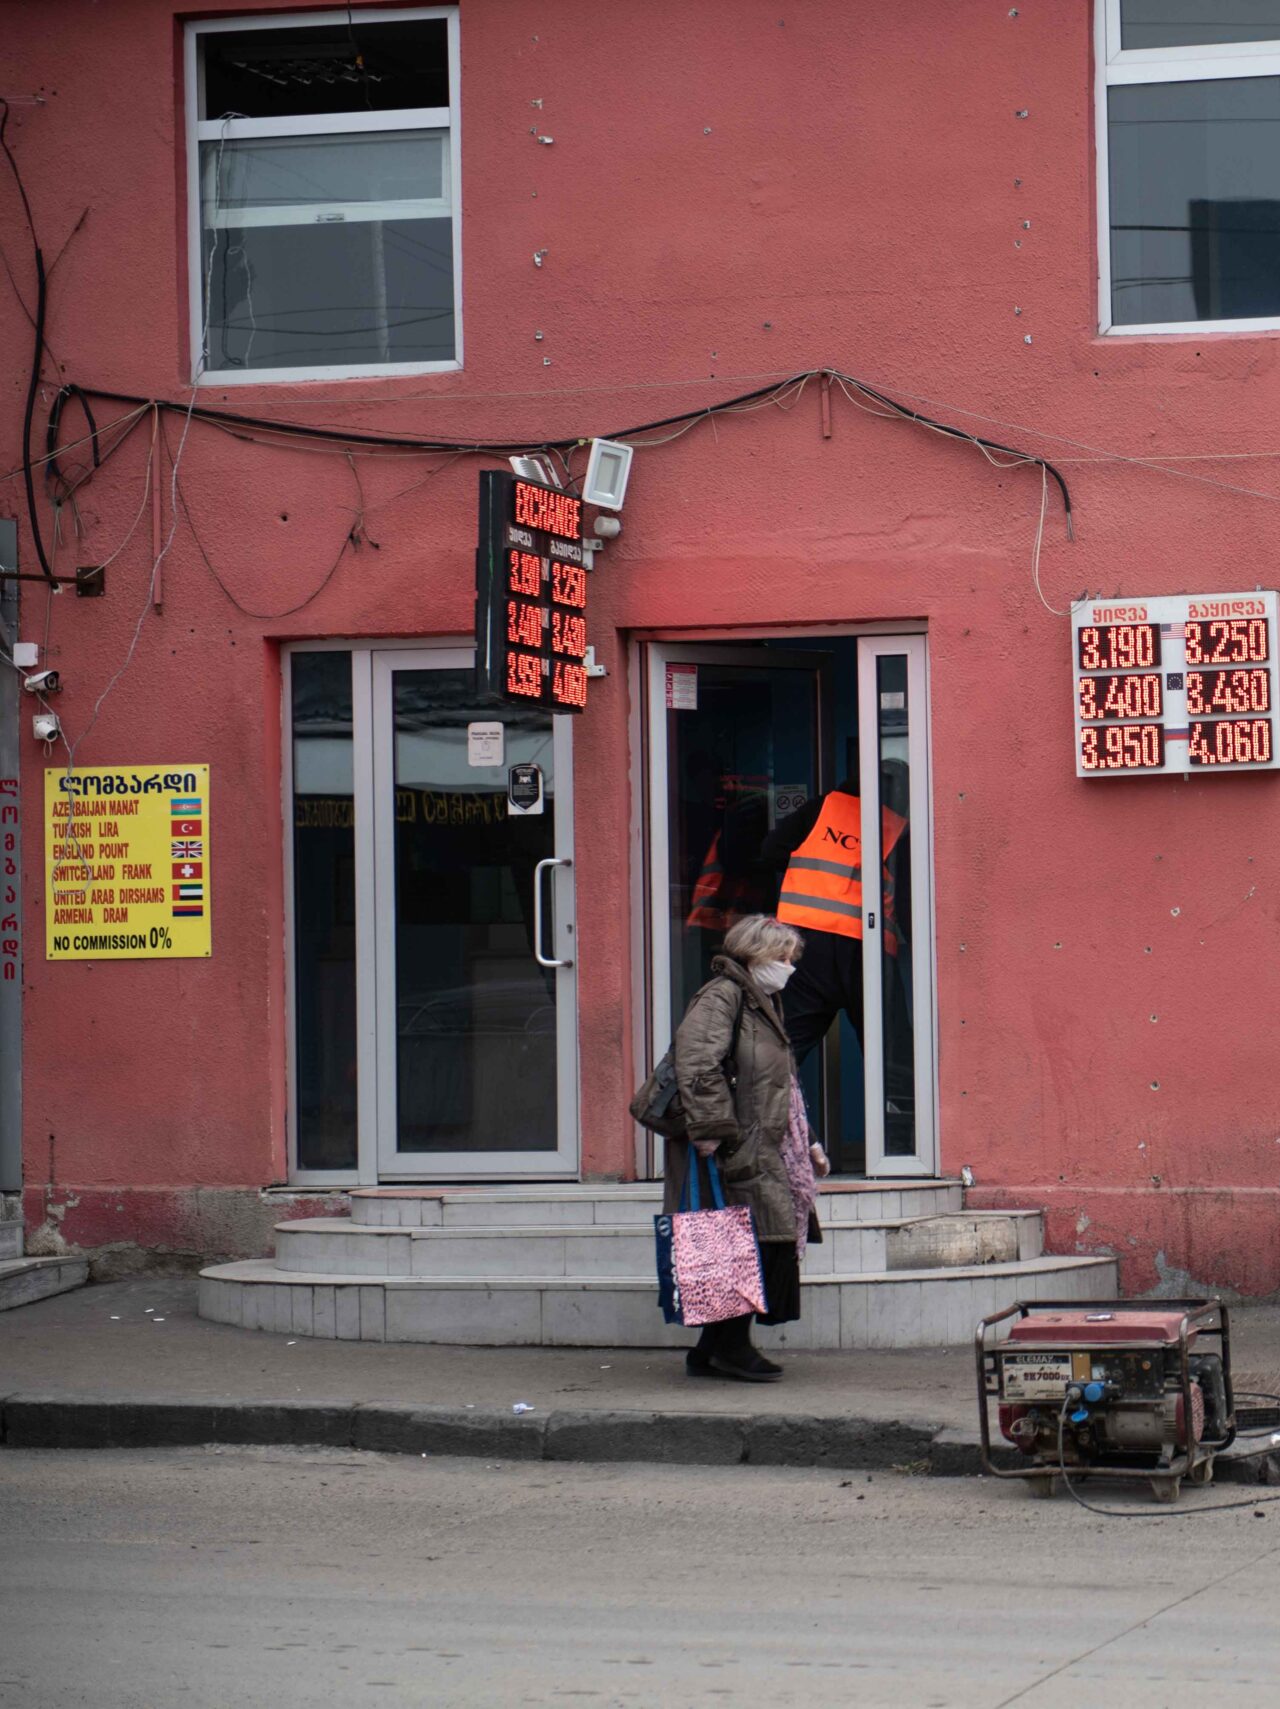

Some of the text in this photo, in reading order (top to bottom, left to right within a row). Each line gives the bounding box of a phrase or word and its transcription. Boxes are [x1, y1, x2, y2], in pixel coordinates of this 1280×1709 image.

[516, 482, 581, 540] EXCHANGE
[508, 527, 533, 549] ყიდვა
[551, 540, 582, 563] გაყიდვა
[510, 550, 541, 597] 3.190
[552, 562, 586, 609] 3.250
[1092, 607, 1148, 623] ყიდვა
[1188, 601, 1266, 619] გაყიდვა
[507, 601, 542, 648] 3.400
[1082, 626, 1153, 669] 3.190
[1185, 620, 1266, 664] 3.250
[1079, 675, 1160, 719] 3.400
[1186, 670, 1268, 714] 3.430
[1081, 725, 1159, 769] 3.950
[1188, 720, 1270, 764] 4.060
[59, 773, 197, 795] ლომბარდი
[52, 799, 139, 817] AZERBAIJAN MANAT
[53, 822, 119, 838] TURKISH LIRA
[53, 843, 129, 859] ENGLAND POUNT
[0, 779, 18, 980] ლომბარდი
[122, 864, 152, 880] FRANK
[54, 888, 164, 906] UNITED ARAB DIRSHAMS
[54, 907, 128, 924] ARMENIA DRAM
[54, 927, 172, 950] NO COMMISSION 0%
